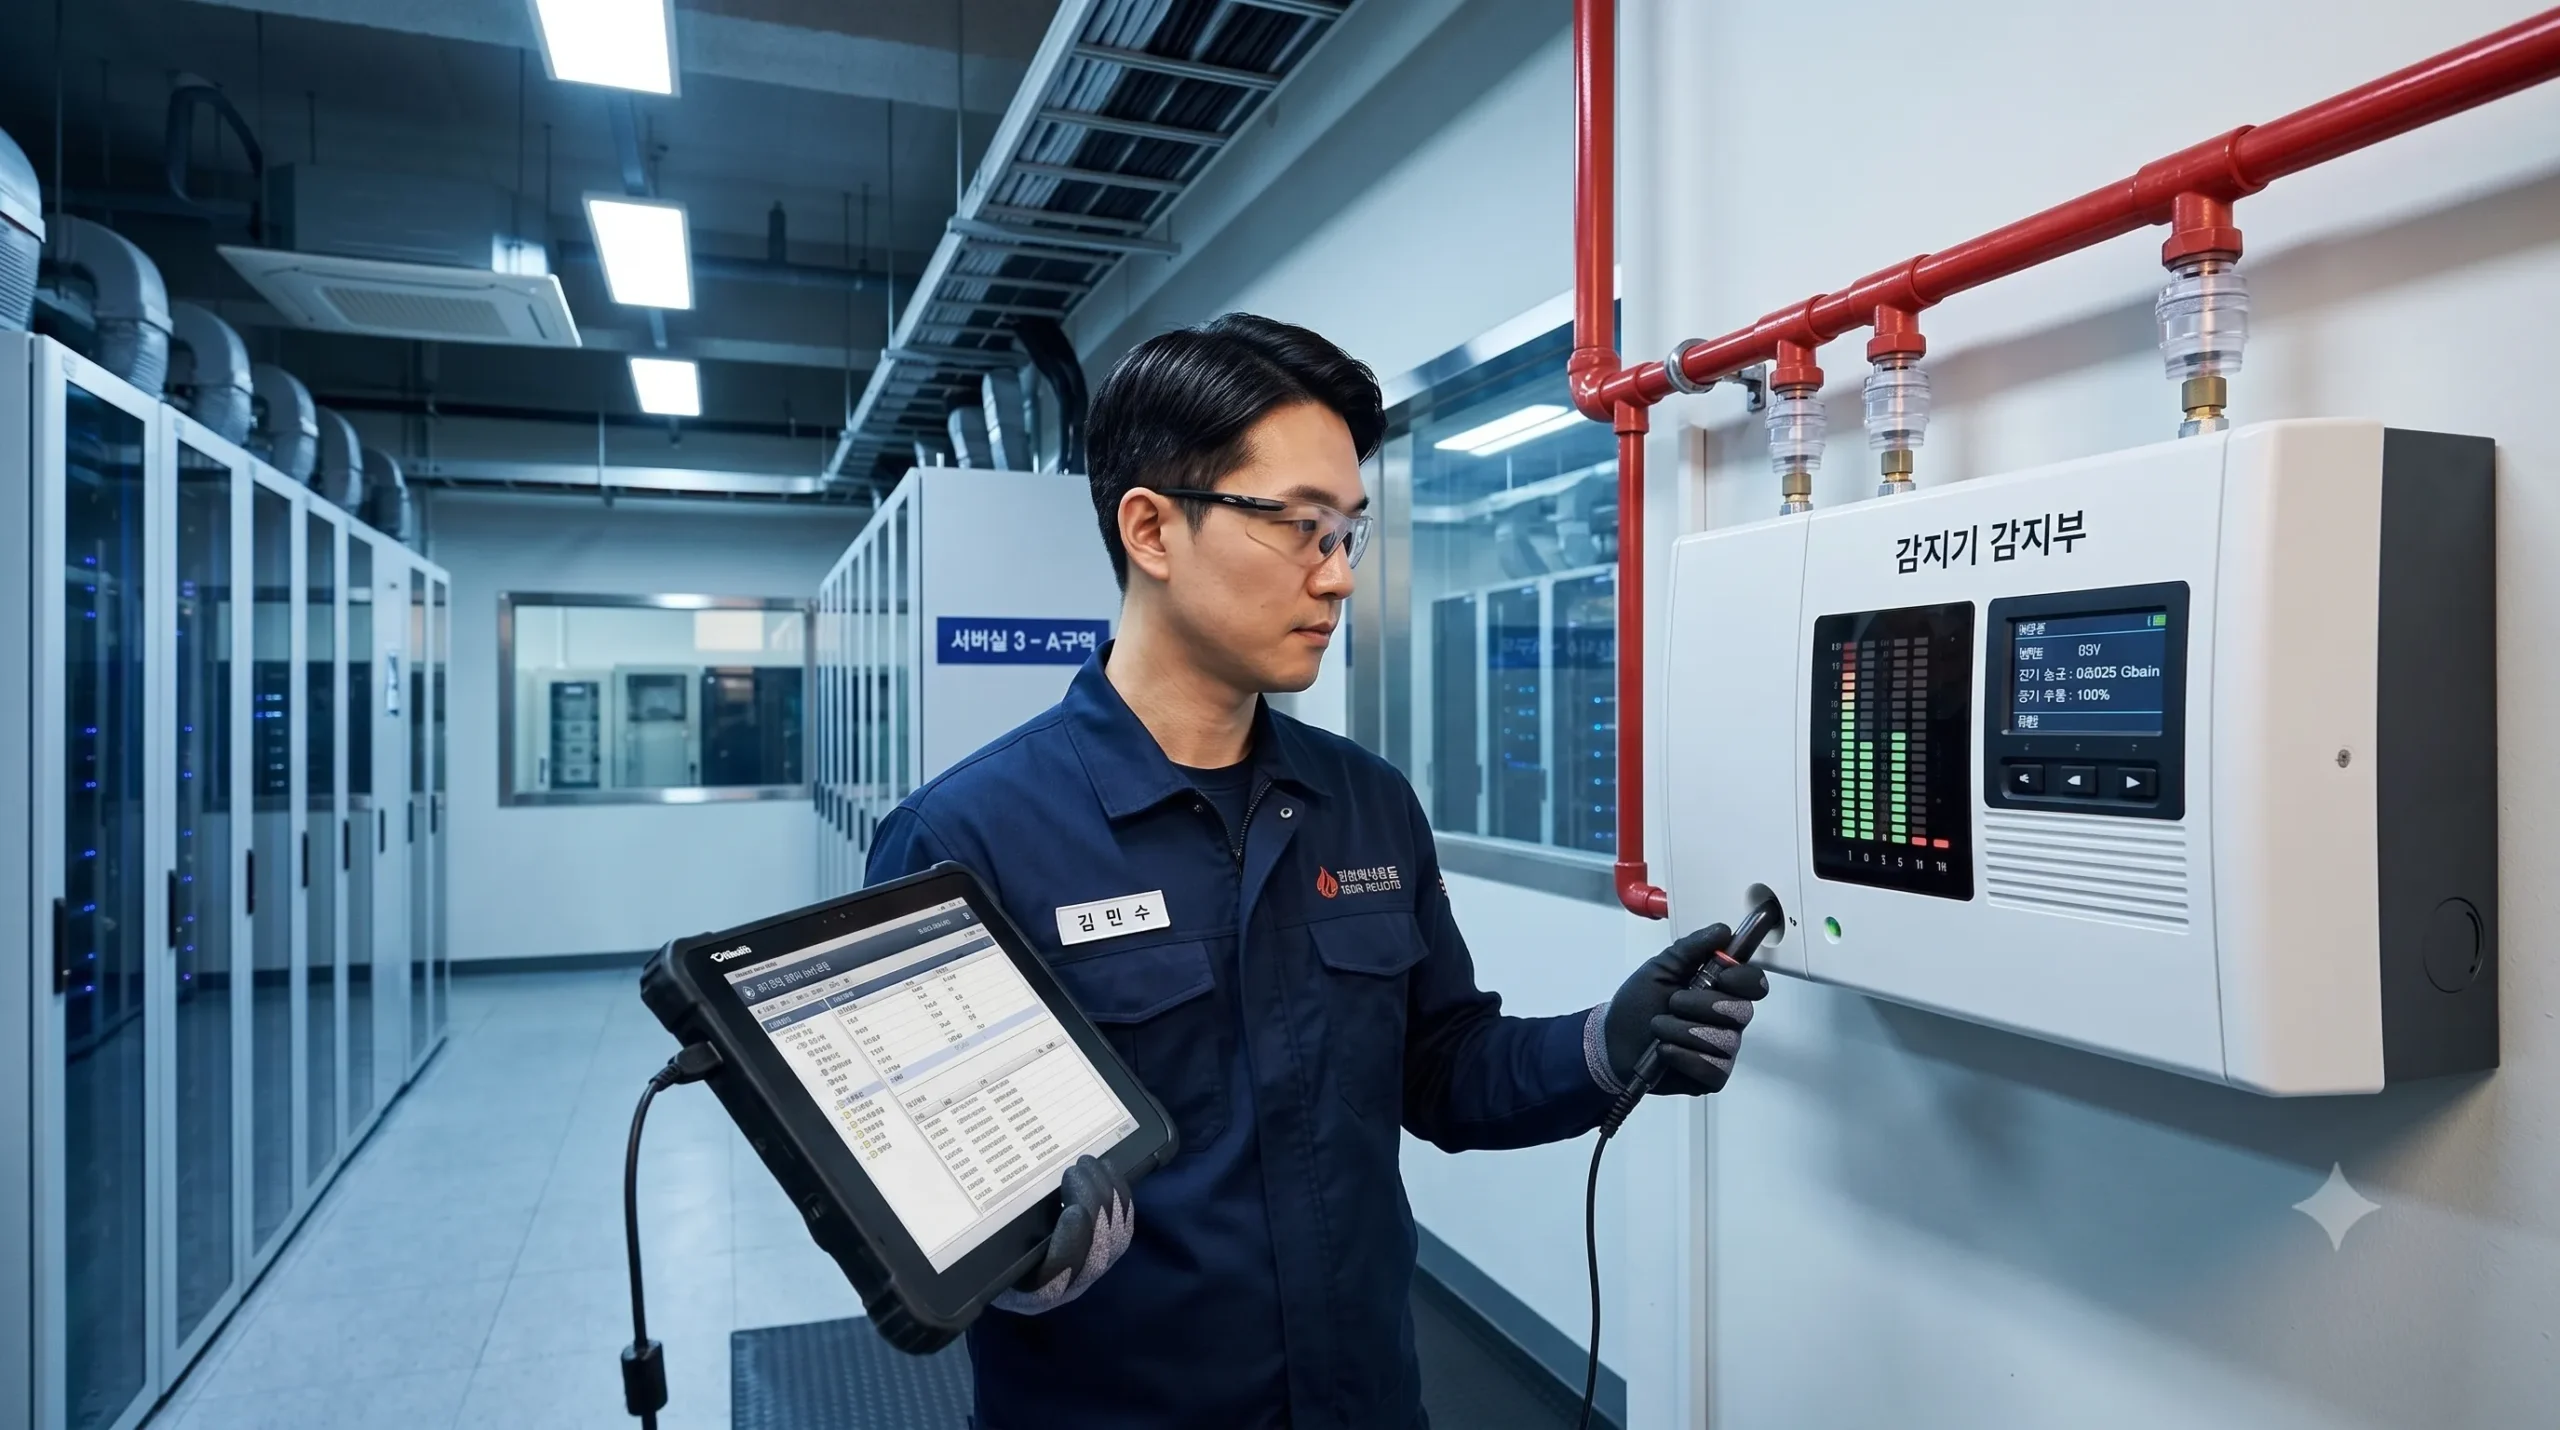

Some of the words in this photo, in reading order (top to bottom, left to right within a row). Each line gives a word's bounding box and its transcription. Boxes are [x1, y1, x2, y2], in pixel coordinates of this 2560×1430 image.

[1895, 524, 1978, 574] 감지기
[1990, 510, 2086, 562] 감지부
[951, 629, 1008, 652] 서버실
[1013, 631, 1026, 651] 3
[1046, 631, 1096, 653] A구역
[2120, 665, 2160, 678] Gbain
[2077, 689, 2110, 700] 100%
[1078, 912, 1095, 932] 김
[1106, 907, 1123, 927] 민
[1134, 904, 1150, 921] 수
